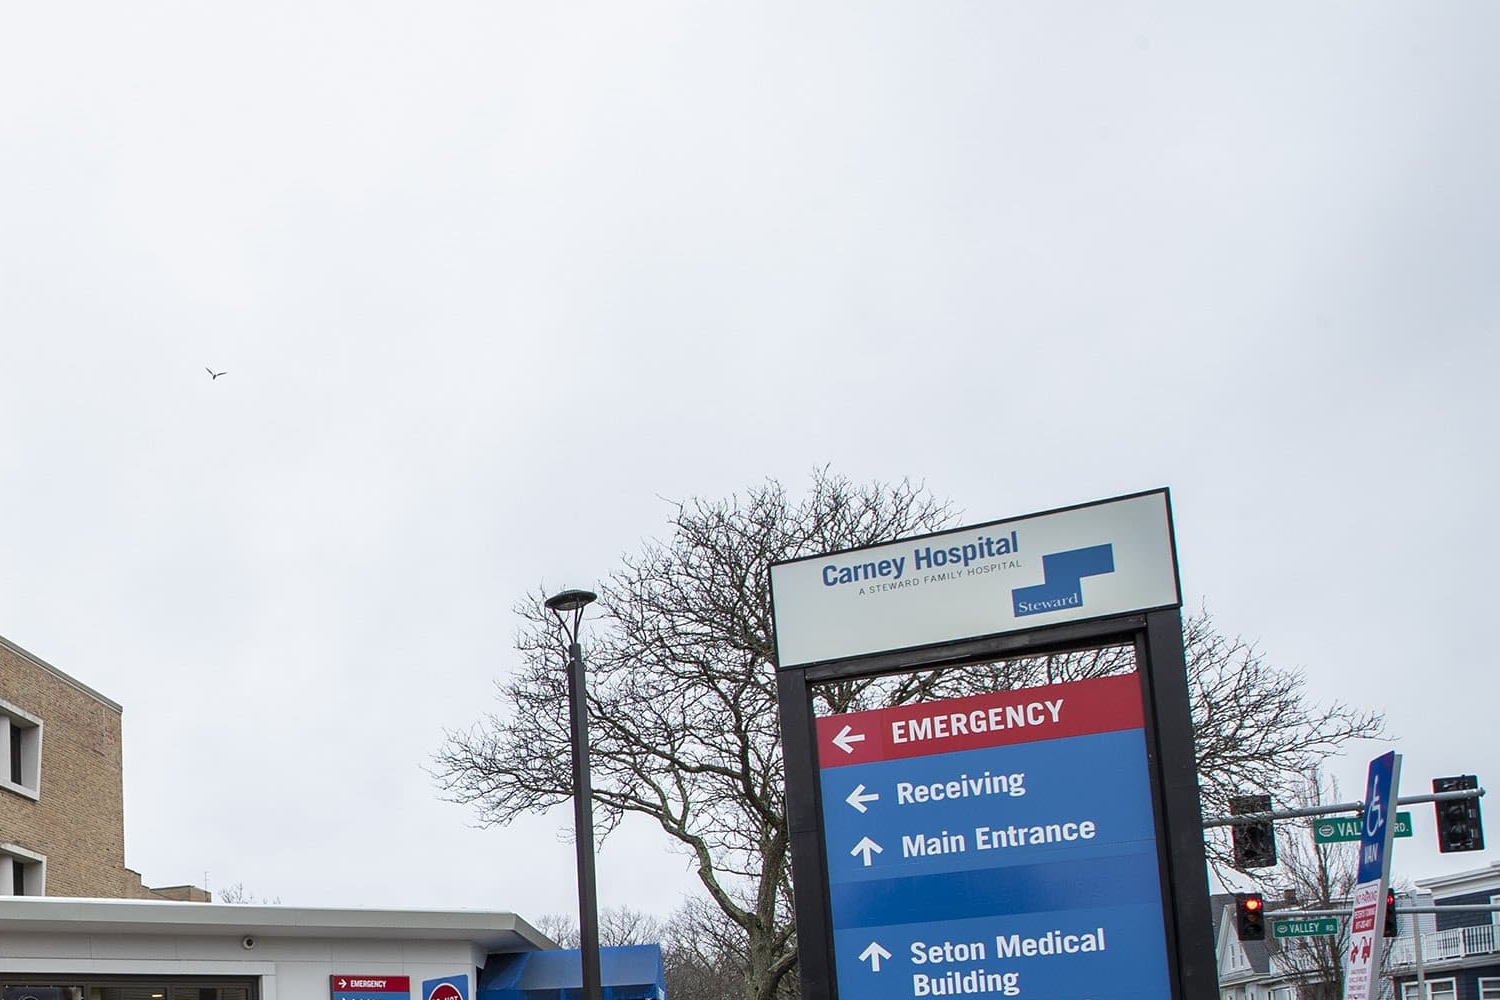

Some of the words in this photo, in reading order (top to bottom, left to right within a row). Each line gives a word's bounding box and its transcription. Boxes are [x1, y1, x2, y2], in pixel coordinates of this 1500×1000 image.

[822, 556, 905, 586] Carney
[914, 531, 1019, 570] Hospital
[858, 588, 866, 596] A
[869, 579, 920, 594] STEWARD
[924, 570, 962, 585] FAMILY
[968, 560, 1022, 576] HOSPITAL
[1018, 592, 1080, 613] Steward
[891, 699, 1064, 744] EMERGENCY
[896, 770, 1026, 806] Receiving
[902, 831, 965, 858] Main
[976, 819, 1096, 851] Entrance
[1337, 822, 1363, 836] VAL
[1289, 922, 1320, 933] VALLEY
[910, 941, 985, 965] Seton
[996, 928, 1106, 959] Medical
[350, 980, 387, 988] EMERGENCY
[913, 971, 1020, 997] Building
